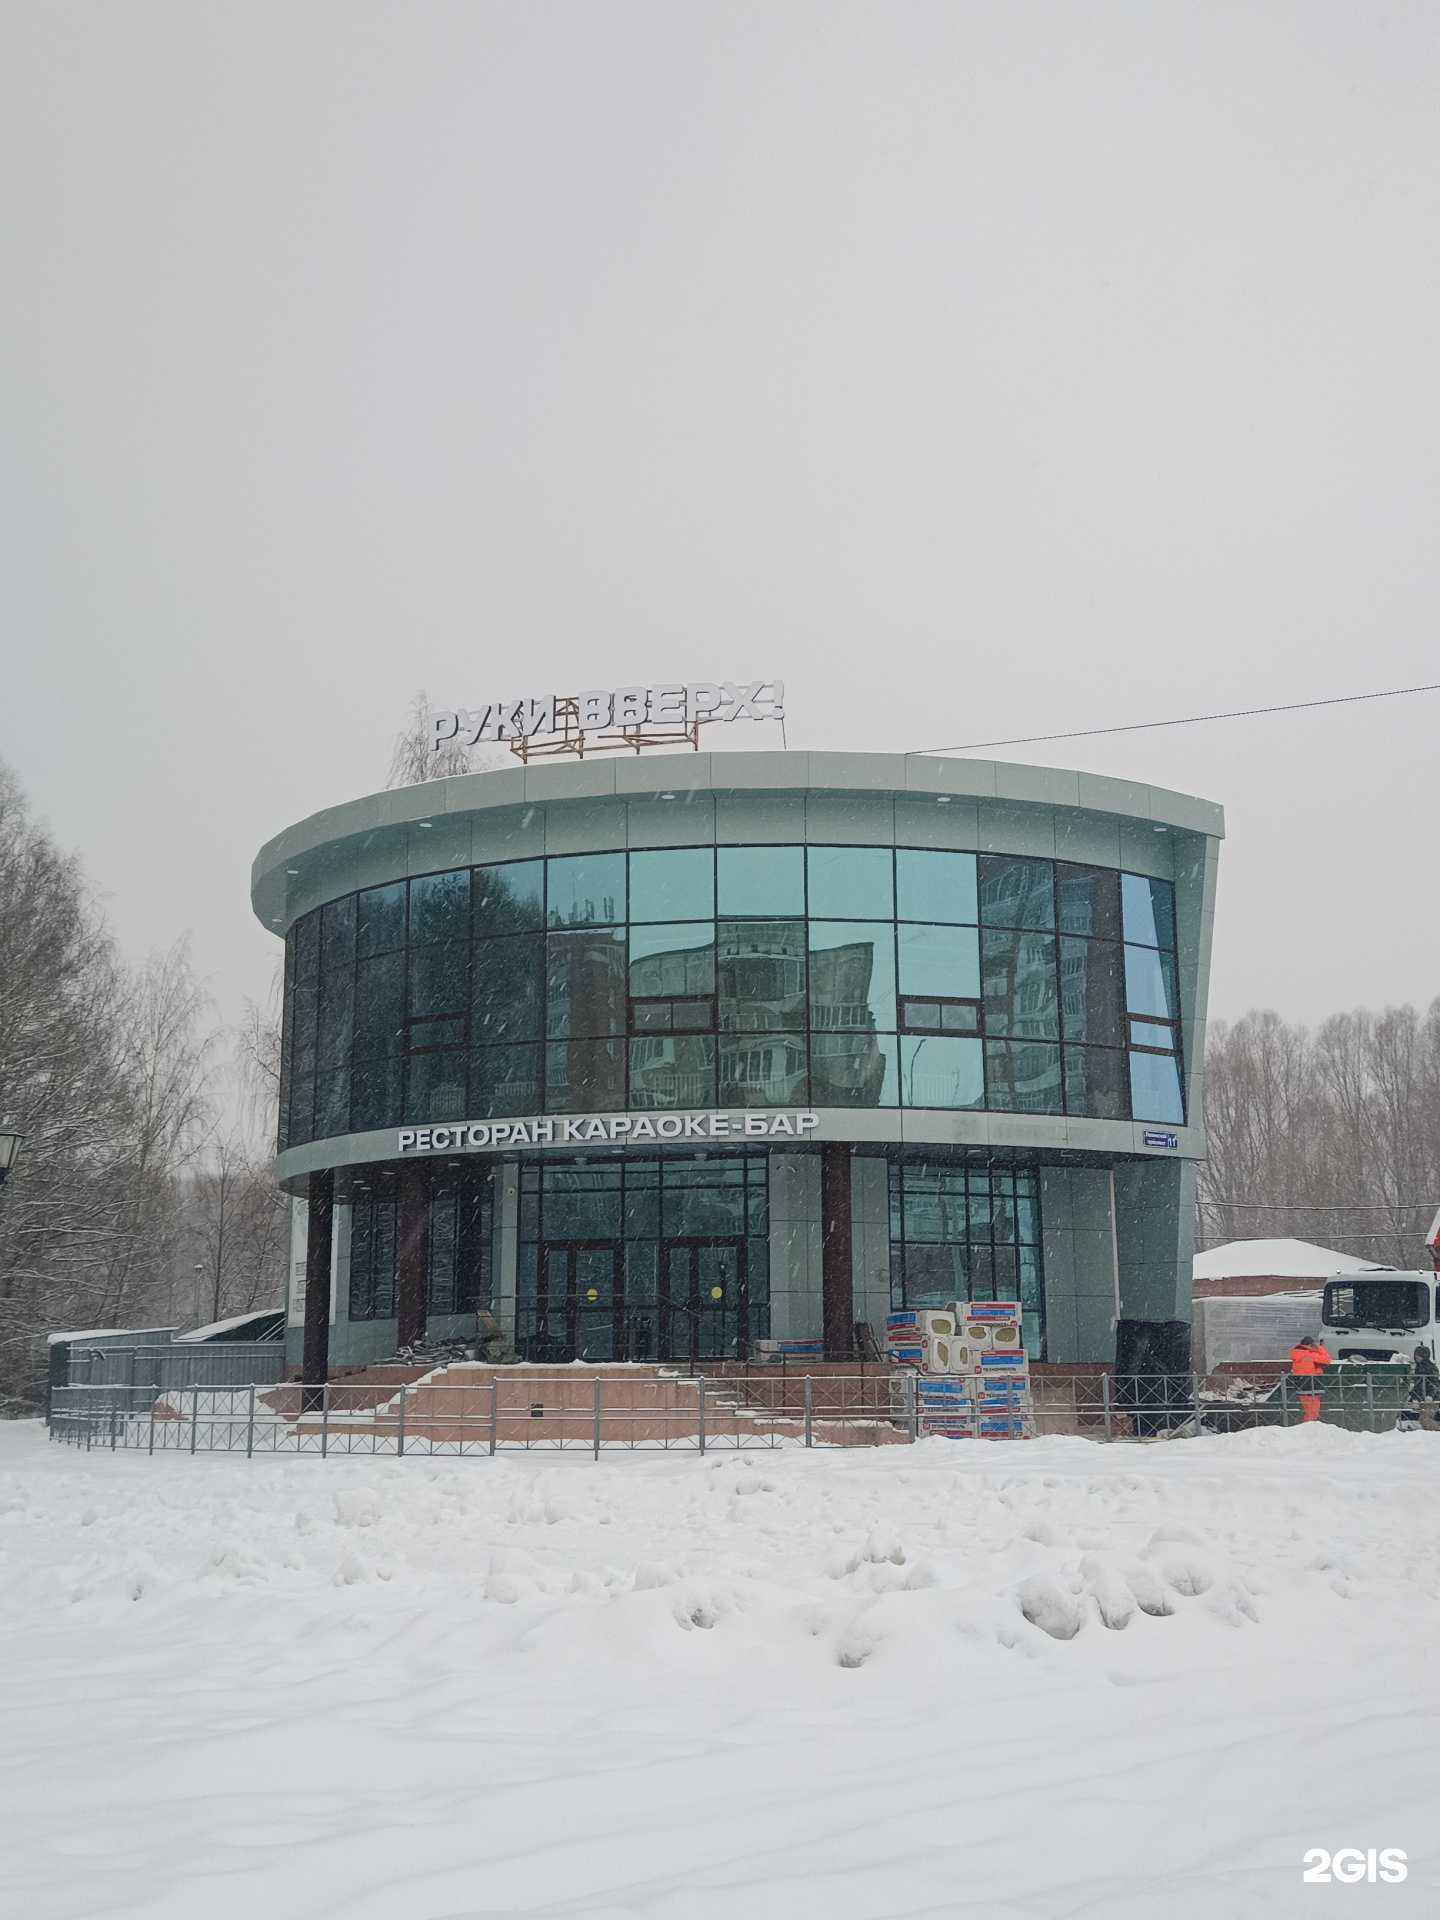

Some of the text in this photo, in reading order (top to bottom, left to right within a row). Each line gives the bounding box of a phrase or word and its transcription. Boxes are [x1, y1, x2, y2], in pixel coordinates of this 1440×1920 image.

[431, 680, 785, 751] РУКИ ВВЕРХ!
[397, 1112, 820, 1151] РЕСТОРАН КАРАОКЕ-БАР
